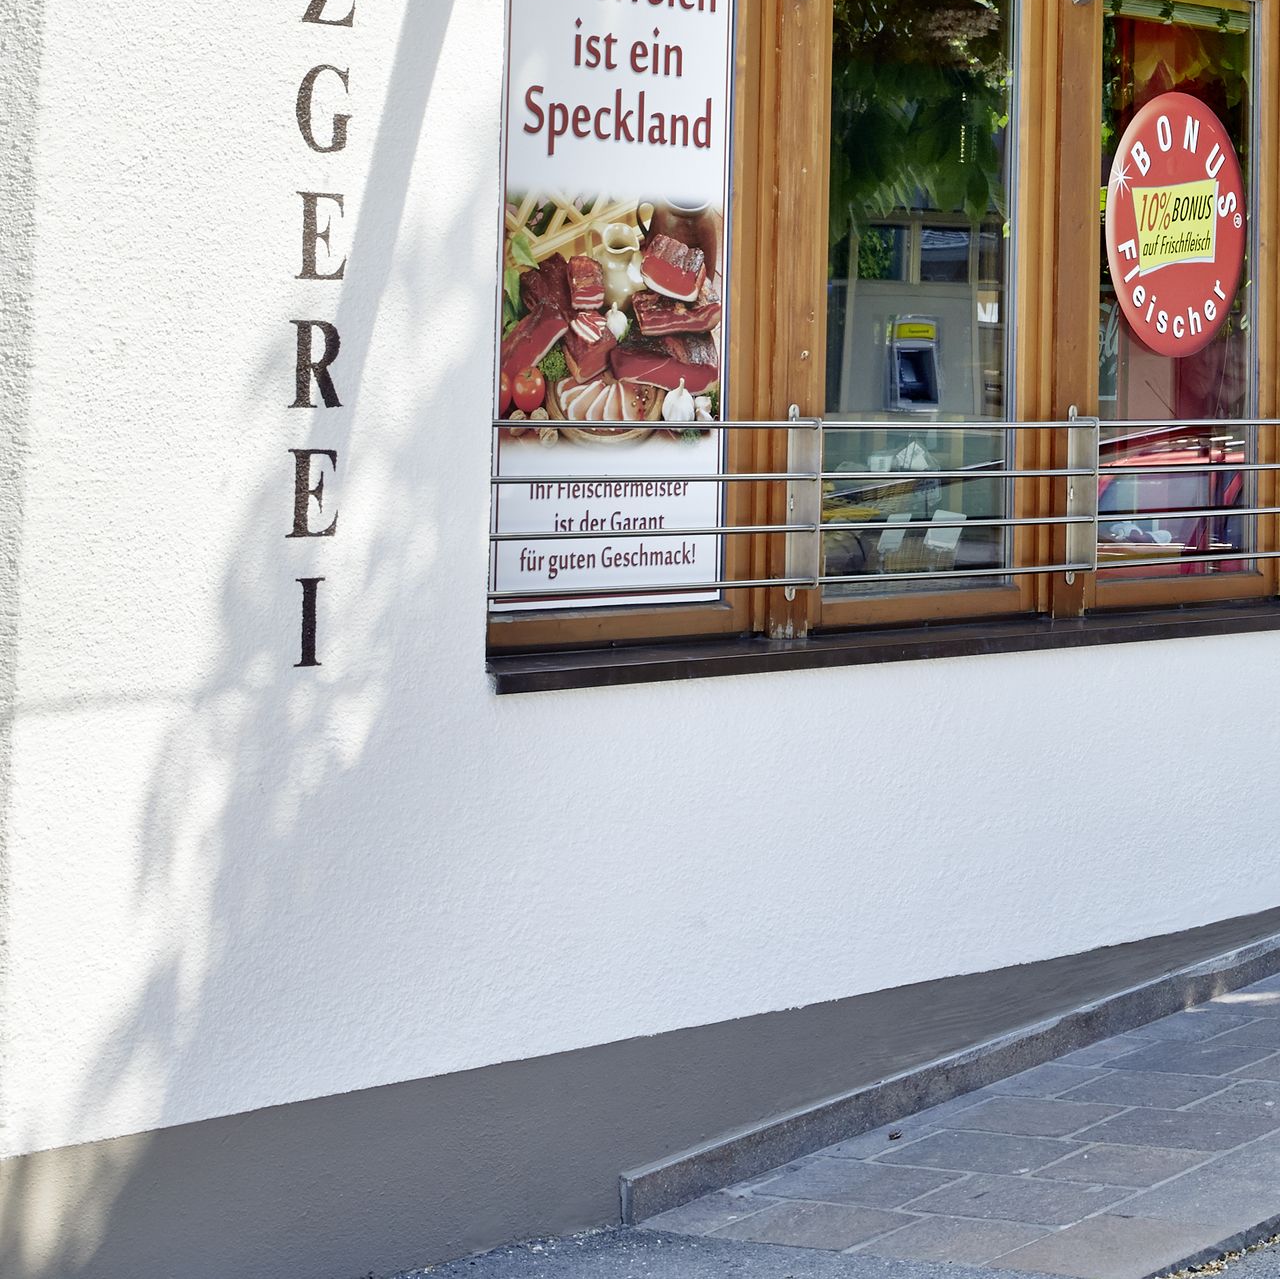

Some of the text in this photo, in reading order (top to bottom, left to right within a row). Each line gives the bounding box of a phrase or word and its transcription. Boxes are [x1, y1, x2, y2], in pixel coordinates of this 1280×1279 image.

[573, 17, 683, 77] ist ein
[523, 84, 713, 157] Speckland
[1139, 191, 1214, 232] 10% BONUS
[1142, 229, 1212, 257] auf Frischfleisch
[1117, 238, 1226, 339] Fleischer
[530, 480, 689, 500] Ihr Fleischermeister
[554, 510, 665, 532] ist der Garant
[520, 542, 697, 579] für guten Geschmack!
